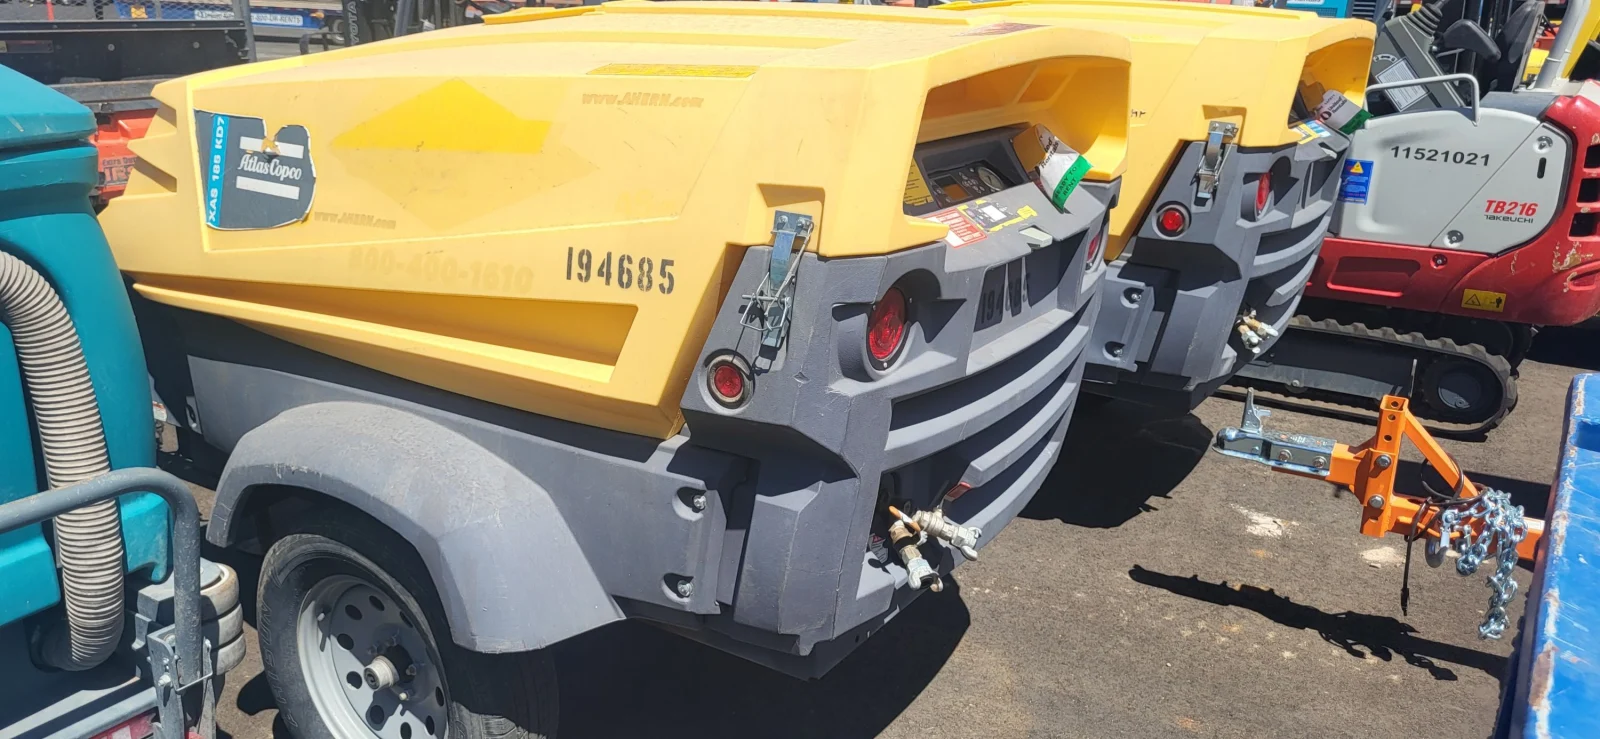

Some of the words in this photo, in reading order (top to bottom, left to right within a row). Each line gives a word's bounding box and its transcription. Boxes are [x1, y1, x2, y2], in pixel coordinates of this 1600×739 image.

[1390, 145, 1490, 167] 11521021
[208, 188, 219, 222] XAS
[214, 116, 225, 150] KD7
[1485, 199, 1539, 217] TB216
